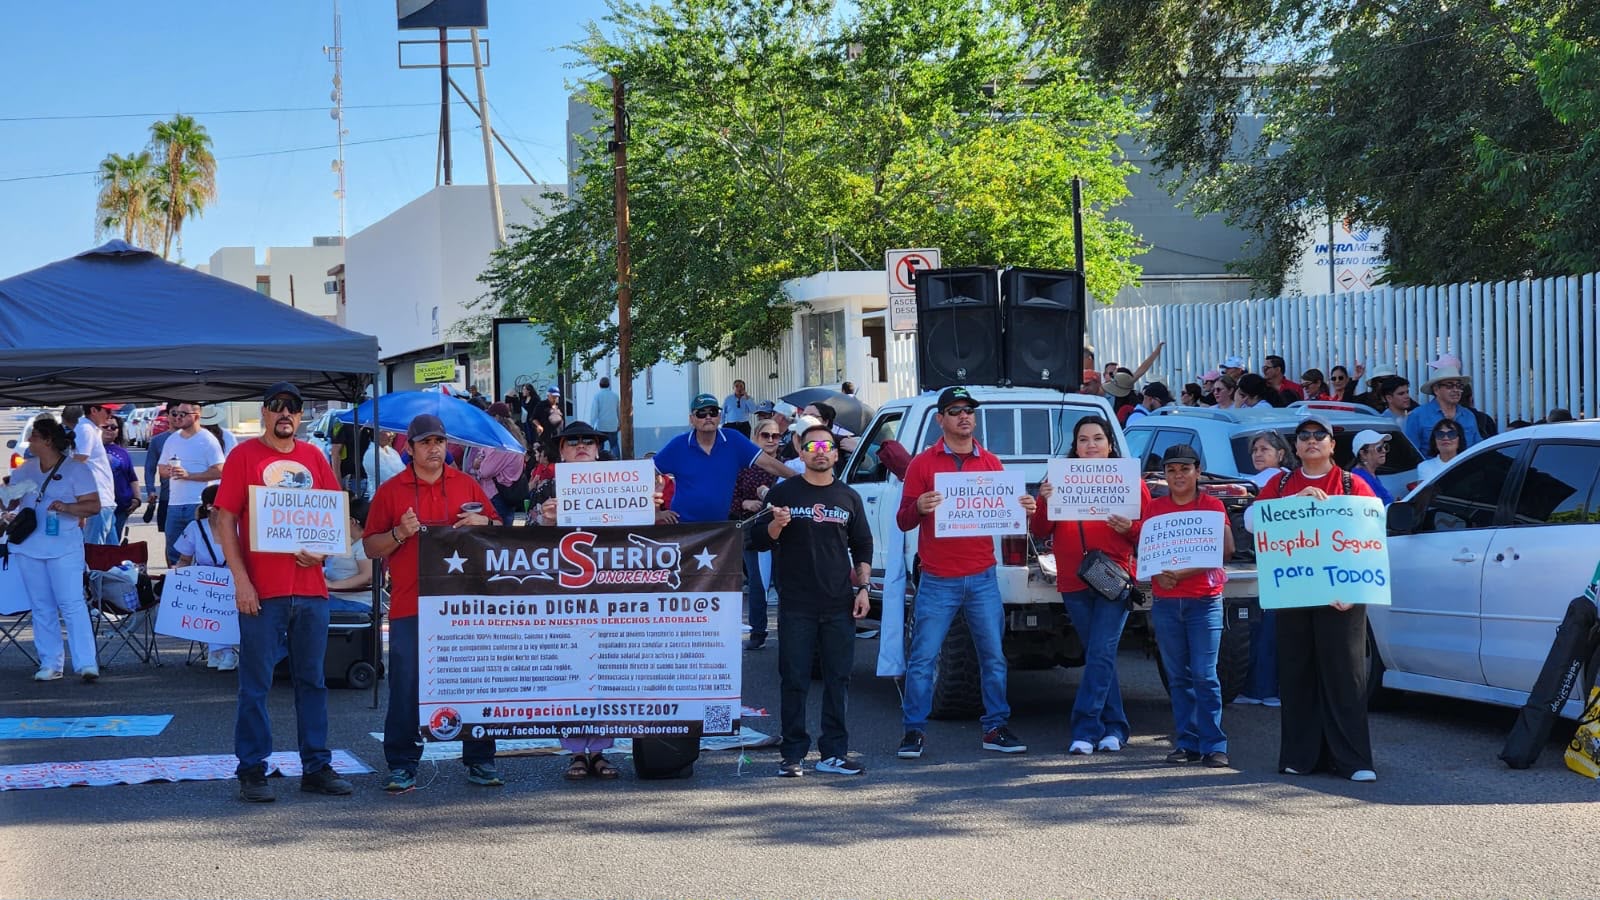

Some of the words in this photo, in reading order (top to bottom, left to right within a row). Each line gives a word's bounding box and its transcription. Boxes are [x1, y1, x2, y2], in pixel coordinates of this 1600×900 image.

[1070, 464, 1118, 472] EXIGIMOS
[571, 471, 639, 484] EXIGIMOS
[562, 487, 605, 496] SERVICIOS
[945, 484, 1014, 499] JUBILACIÓN
[1076, 486, 1130, 495] QUEREMOS
[564, 500, 580, 511] DE
[586, 496, 648, 510] CALIDAD
[956, 496, 1004, 509] DIGNA
[272, 509, 334, 528] DIGNA
[791, 504, 849, 522] MAGISTERIO
[948, 510, 974, 519] PARA
[976, 510, 1012, 518] TOD@S
[1261, 502, 1353, 523] Necesitamos
[1364, 507, 1379, 518] un
[1153, 522, 1162, 530] EL
[1166, 517, 1202, 528] FONDO
[267, 528, 292, 539] PARA
[296, 528, 341, 541] TOD@S!
[1144, 536, 1155, 544] DE
[1157, 528, 1213, 540] PENSIONES
[1257, 529, 1319, 556] Hospital
[1332, 530, 1382, 553] Seguro
[486, 532, 677, 588] MAGISTERIO
[1274, 566, 1314, 587] para
[1322, 566, 1385, 586] TODOS
[439, 599, 539, 616] Jubilación
[546, 598, 599, 615] DIGNA
[608, 600, 649, 616] para
[658, 597, 720, 613] TOD@S
[182, 615, 220, 632] ROTO
[488, 618, 531, 626] DEFENSA
[549, 617, 598, 626] NUESTROS
[1551, 659, 1580, 713] SelectShop
[482, 704, 679, 719] #AbrogaciónLeyISSSTE2007
[487, 724, 689, 737] www.facebook.com/MagisterioSonorense
